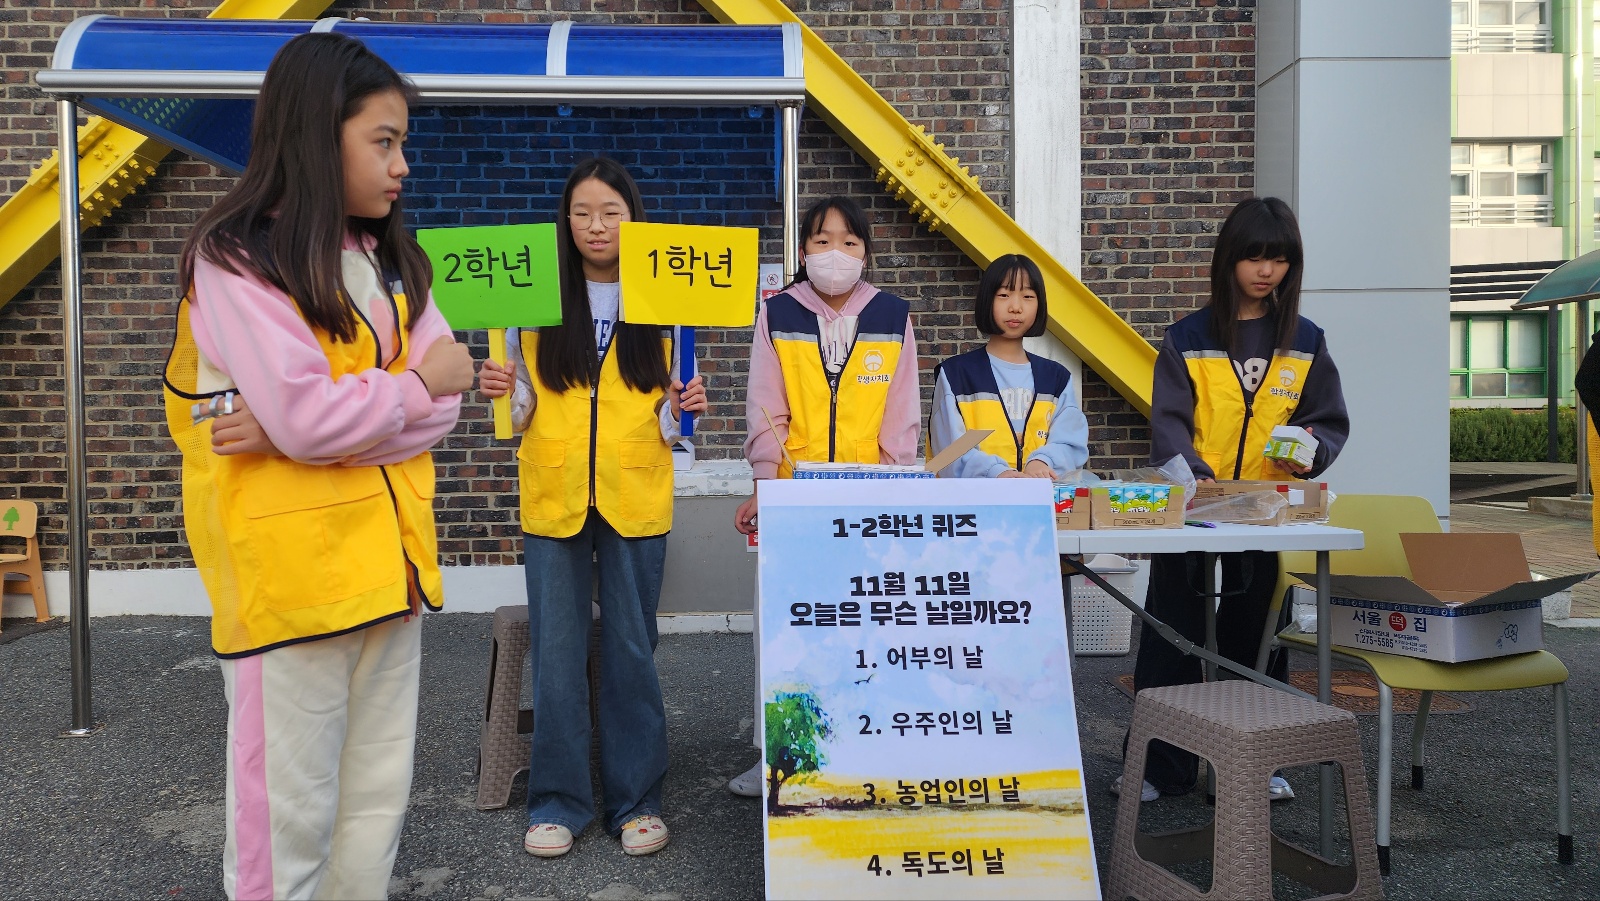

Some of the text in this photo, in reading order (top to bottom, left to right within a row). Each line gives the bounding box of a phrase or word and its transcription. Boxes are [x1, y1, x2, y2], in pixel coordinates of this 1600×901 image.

[442, 244, 533, 289] 2학년
[647, 245, 732, 288] 1학년
[832, 513, 978, 538] 1-2학년 퀴즈
[850, 571, 971, 597] 11월 11일
[790, 600, 1032, 627] 오늘은 무슨 날일까요?
[1352, 609, 1428, 633] 서울 떡 집
[1353, 634, 1394, 649] T.275-5585
[856, 645, 984, 671] 1. 어부의 날
[858, 709, 1013, 737] 2. 우주인의 날
[862, 776, 1021, 805] 3. 농업인의 날
[866, 847, 1005, 878] 4. 독도의 날
